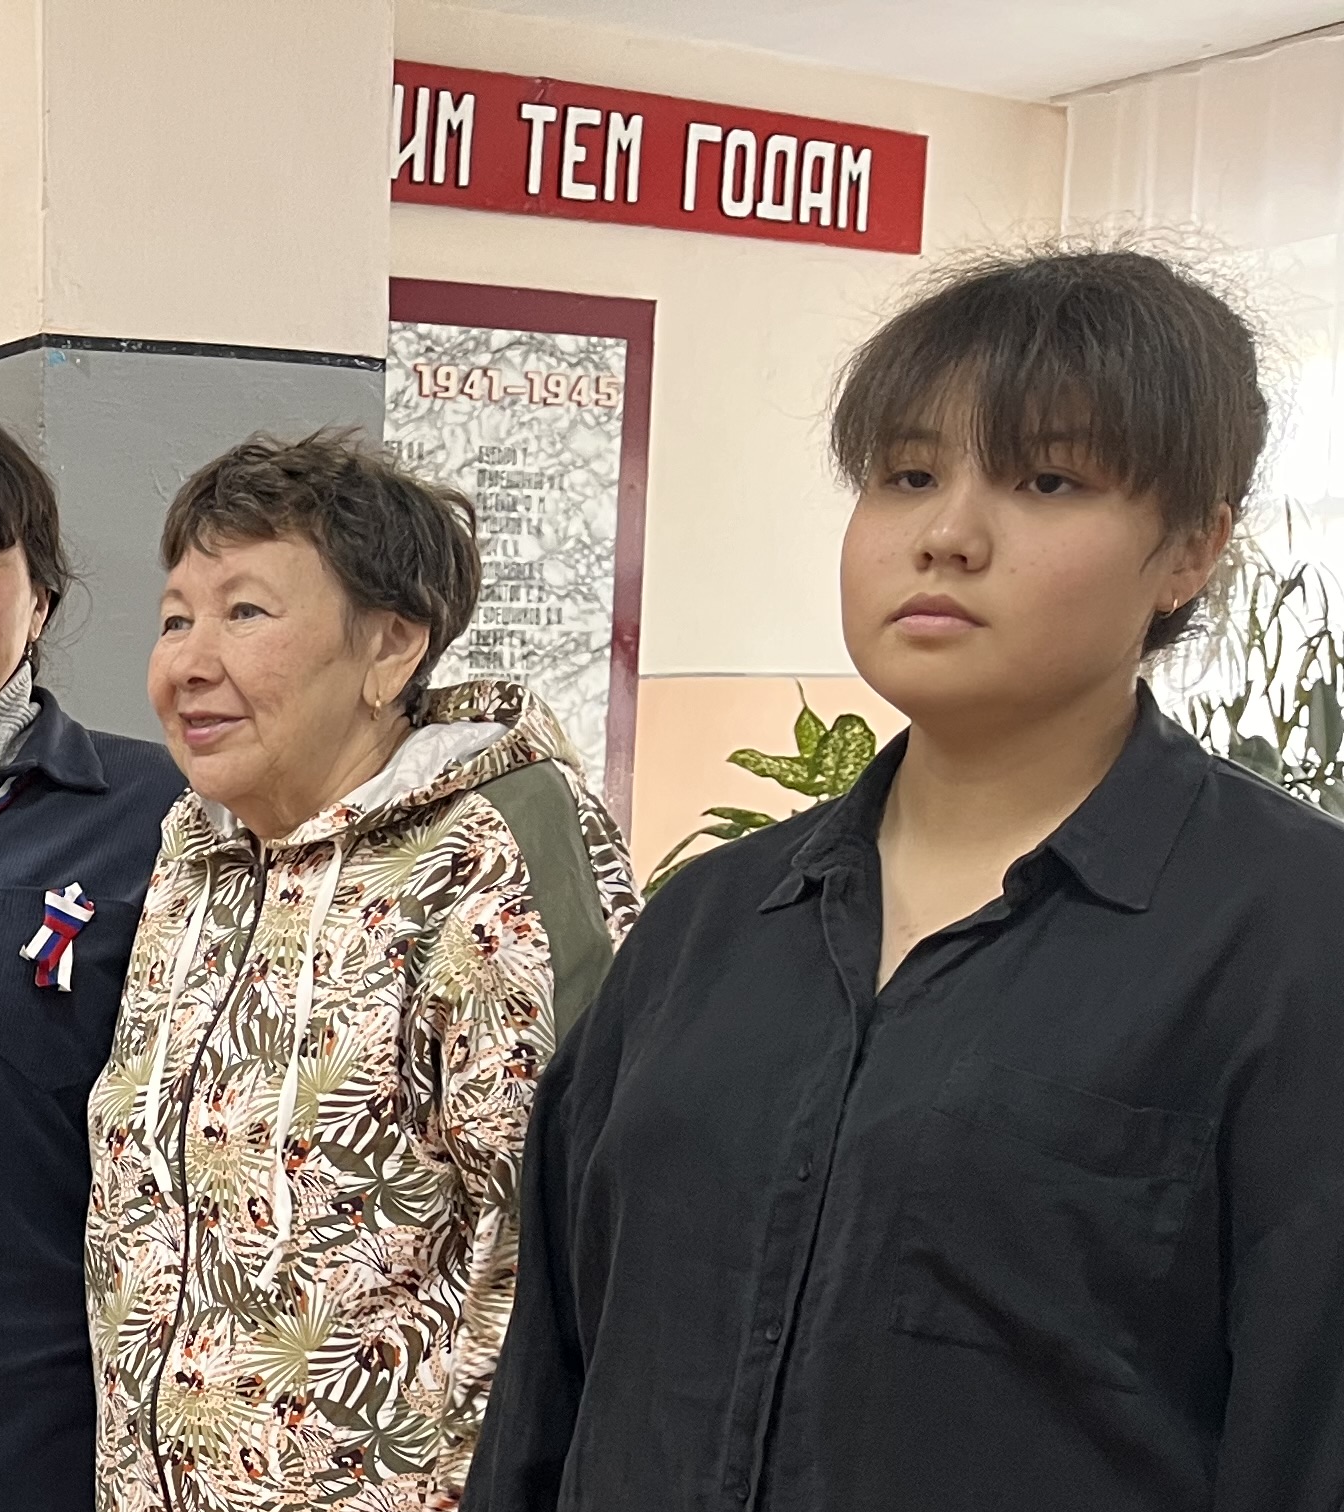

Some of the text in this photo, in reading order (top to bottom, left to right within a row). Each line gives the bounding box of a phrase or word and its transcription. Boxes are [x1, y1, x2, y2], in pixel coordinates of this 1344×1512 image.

[520, 102, 643, 203] ТЕМ
[683, 122, 872, 233] ГОДАМ
[414, 362, 622, 408] 1941-1945
